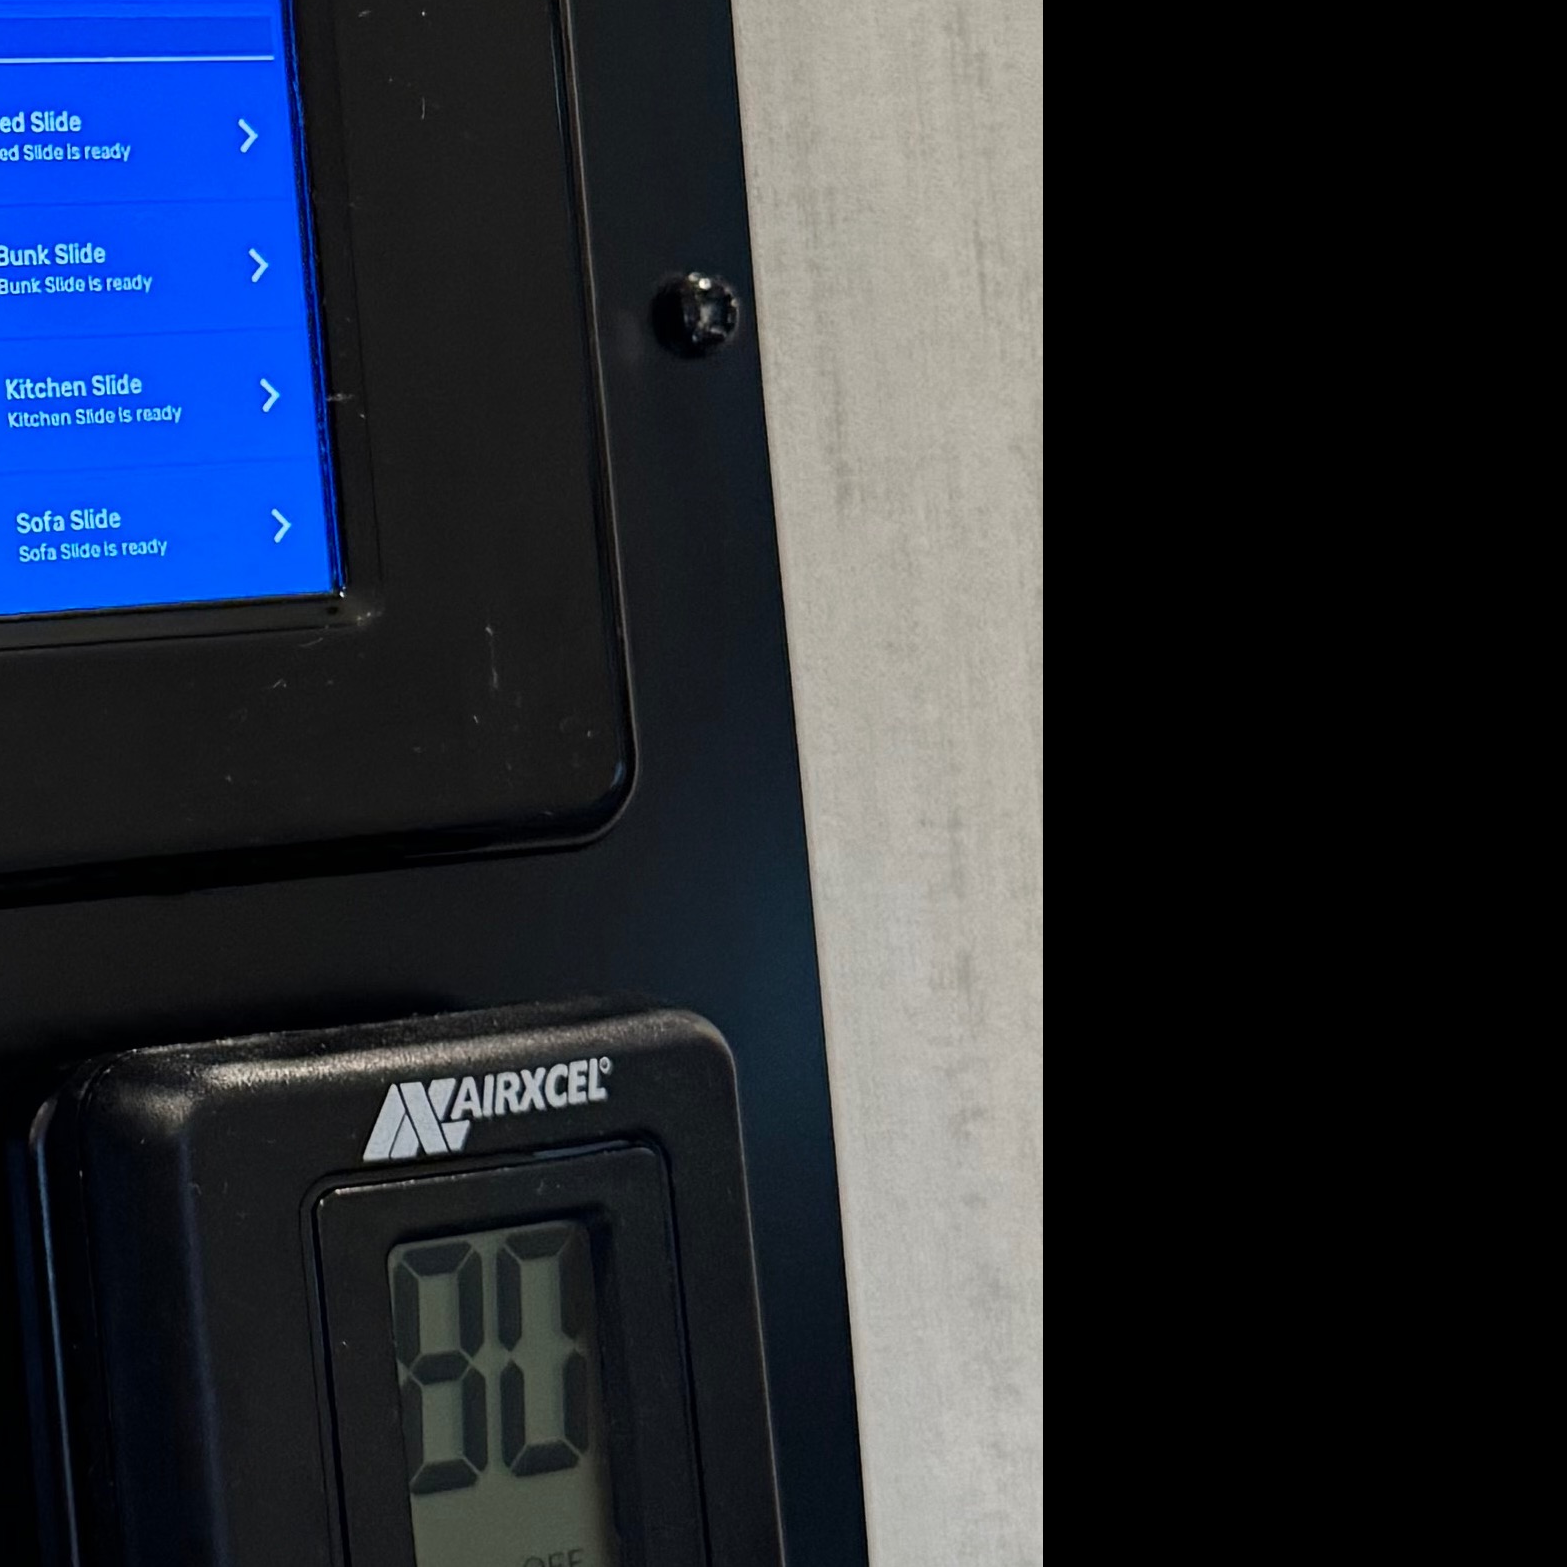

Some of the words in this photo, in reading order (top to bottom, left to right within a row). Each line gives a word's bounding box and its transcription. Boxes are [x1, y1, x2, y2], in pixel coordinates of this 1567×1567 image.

[30, 111, 82, 133] Slide
[23, 144, 64, 161] Slide
[67, 144, 81, 160] is
[84, 143, 131, 162] ready
[54, 243, 106, 265] Slide
[45, 277, 86, 293] Slide
[89, 276, 103, 292] is
[105, 275, 153, 294] ready
[5, 376, 87, 401] Kitchen
[91, 375, 143, 397] Slide
[7, 410, 72, 429] Kitchen
[75, 408, 116, 427] Slide
[118, 407, 132, 425] is
[135, 405, 182, 426] ready
[16, 512, 66, 534] Sofa
[69, 509, 122, 531] Slide
[19, 545, 58, 562] Sofa
[60, 543, 101, 562] Slide
[104, 542, 118, 559] is
[121, 540, 168, 560] ready
[392, 1229, 589, 1496] 80
